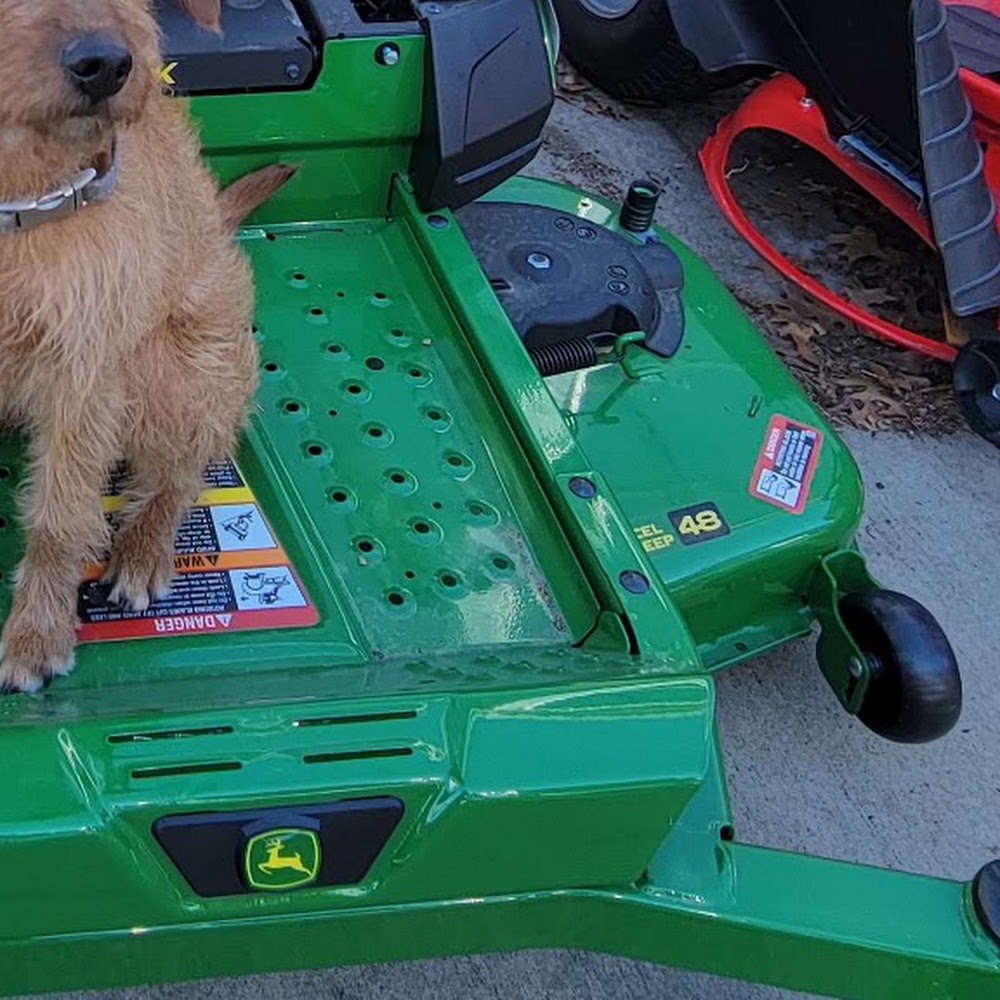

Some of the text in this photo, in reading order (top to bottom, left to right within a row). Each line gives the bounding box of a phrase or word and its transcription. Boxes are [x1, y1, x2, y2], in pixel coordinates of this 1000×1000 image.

[678, 510, 722, 536] 48
[641, 534, 675, 553] EEP
[154, 615, 216, 631] DANGER
